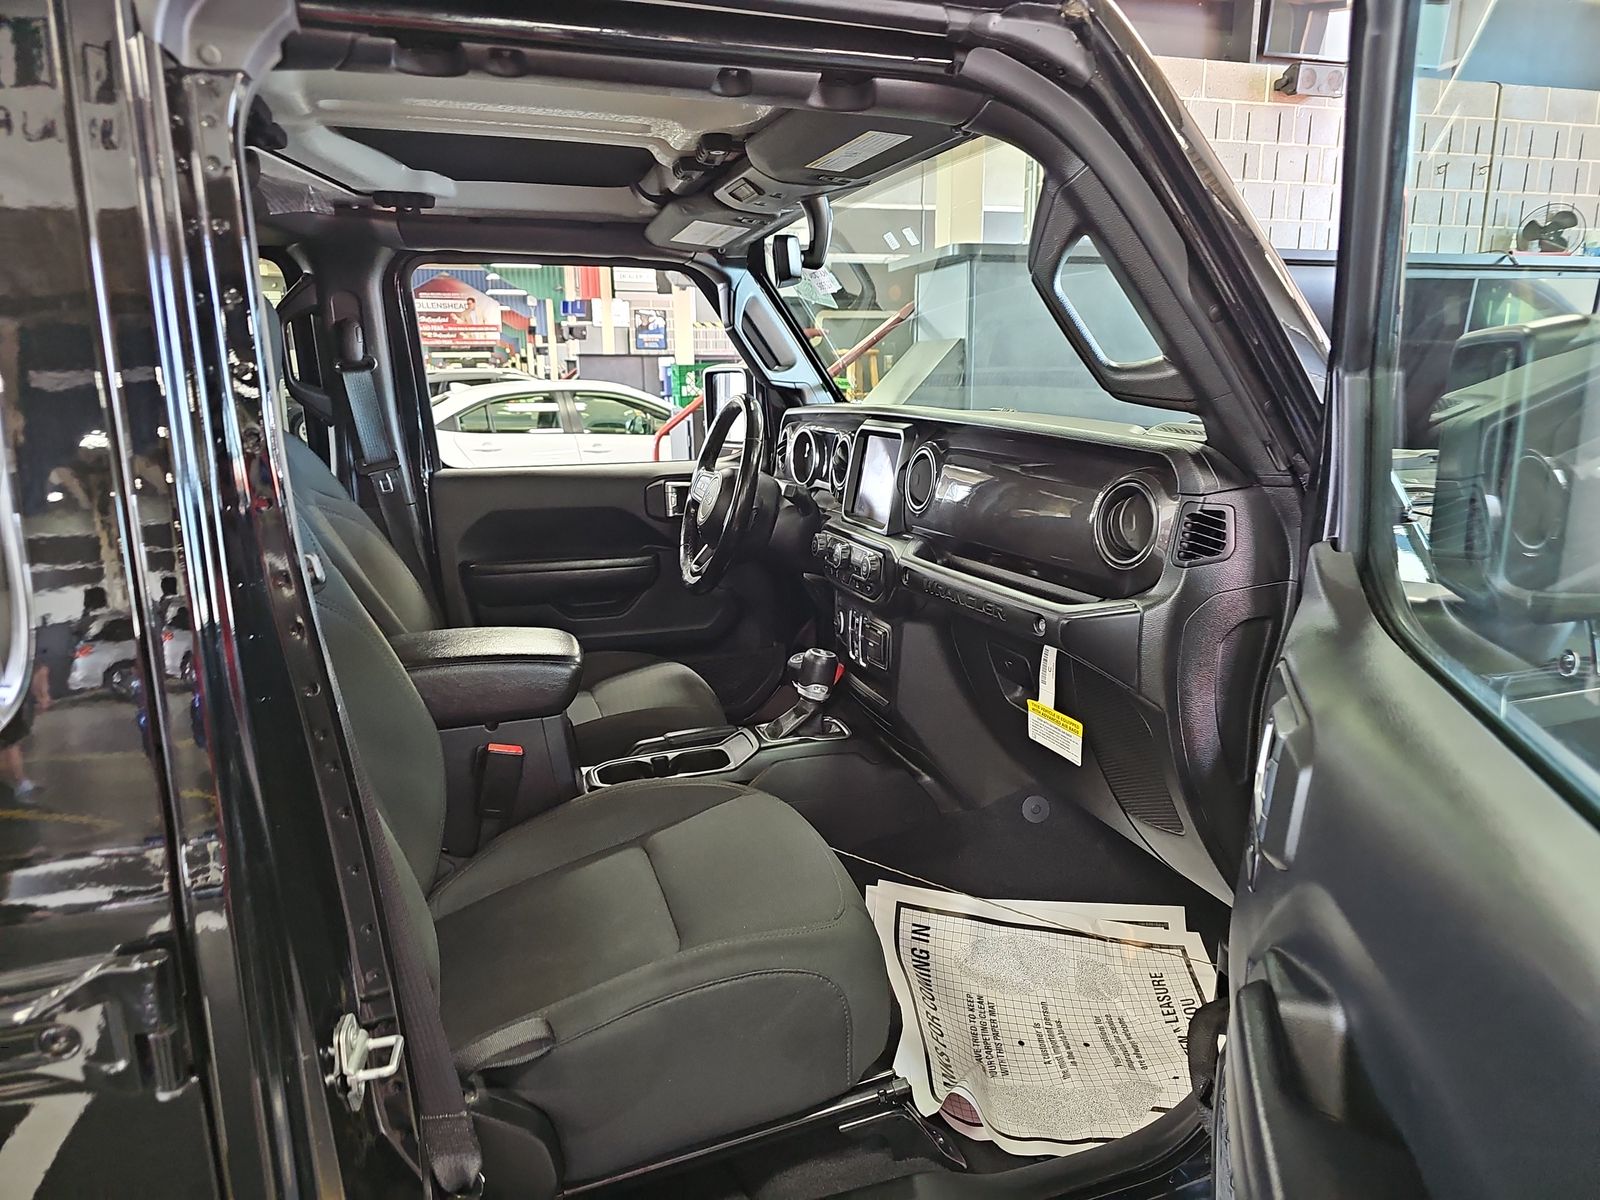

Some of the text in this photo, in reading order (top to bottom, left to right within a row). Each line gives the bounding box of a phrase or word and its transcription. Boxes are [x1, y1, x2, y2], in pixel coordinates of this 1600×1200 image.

[922, 577, 1007, 621] WRANGLER
[911, 923, 957, 1090] ANKS FOR COMING IN
[1149, 972, 1179, 1024] LEASURE
[966, 993, 983, 1064] AVE TRIED TO KEEP
[1041, 1001, 1053, 1027] person
[1094, 1015, 1102, 1024] for
[1105, 1013, 1118, 1035] service
[977, 995, 998, 1078] YOUR CARPETING CLEAN
[988, 1001, 1010, 1077] WITH THIS PAPER MAT
[1036, 1029, 1051, 1059] customer
[1045, 1027, 1062, 1055] important
[1055, 1055, 1067, 1070] most
[1137, 1060, 1148, 1070] are
